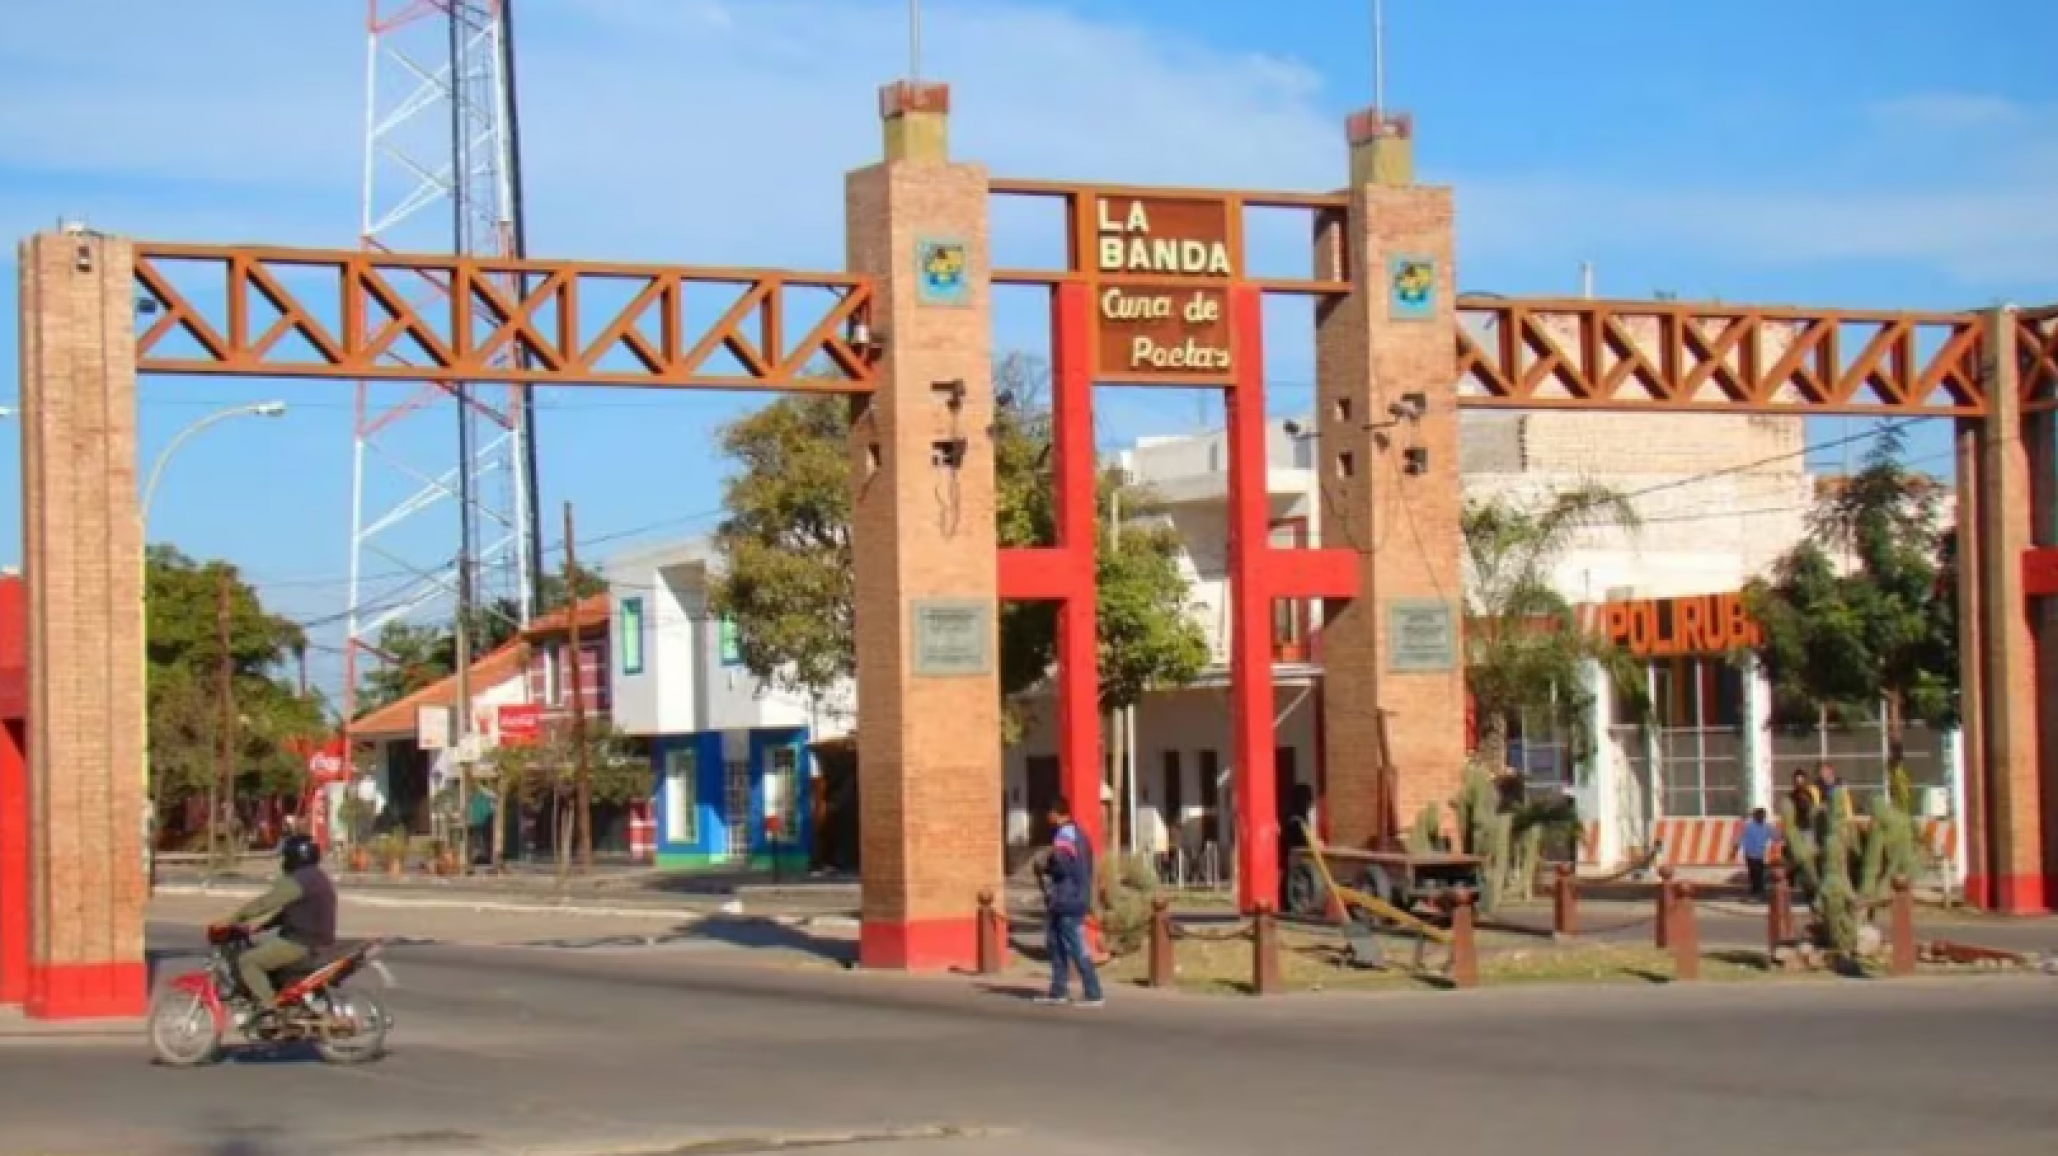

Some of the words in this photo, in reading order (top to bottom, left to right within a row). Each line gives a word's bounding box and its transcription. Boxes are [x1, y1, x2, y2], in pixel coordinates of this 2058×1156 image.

[1098, 199, 1149, 233] LA
[1100, 236, 1230, 273] BANDA
[1103, 287, 1172, 319] Cuna
[1184, 290, 1219, 321] de
[1131, 336, 1230, 367] Poetas
[1605, 592, 1765, 657] POLIRUB
